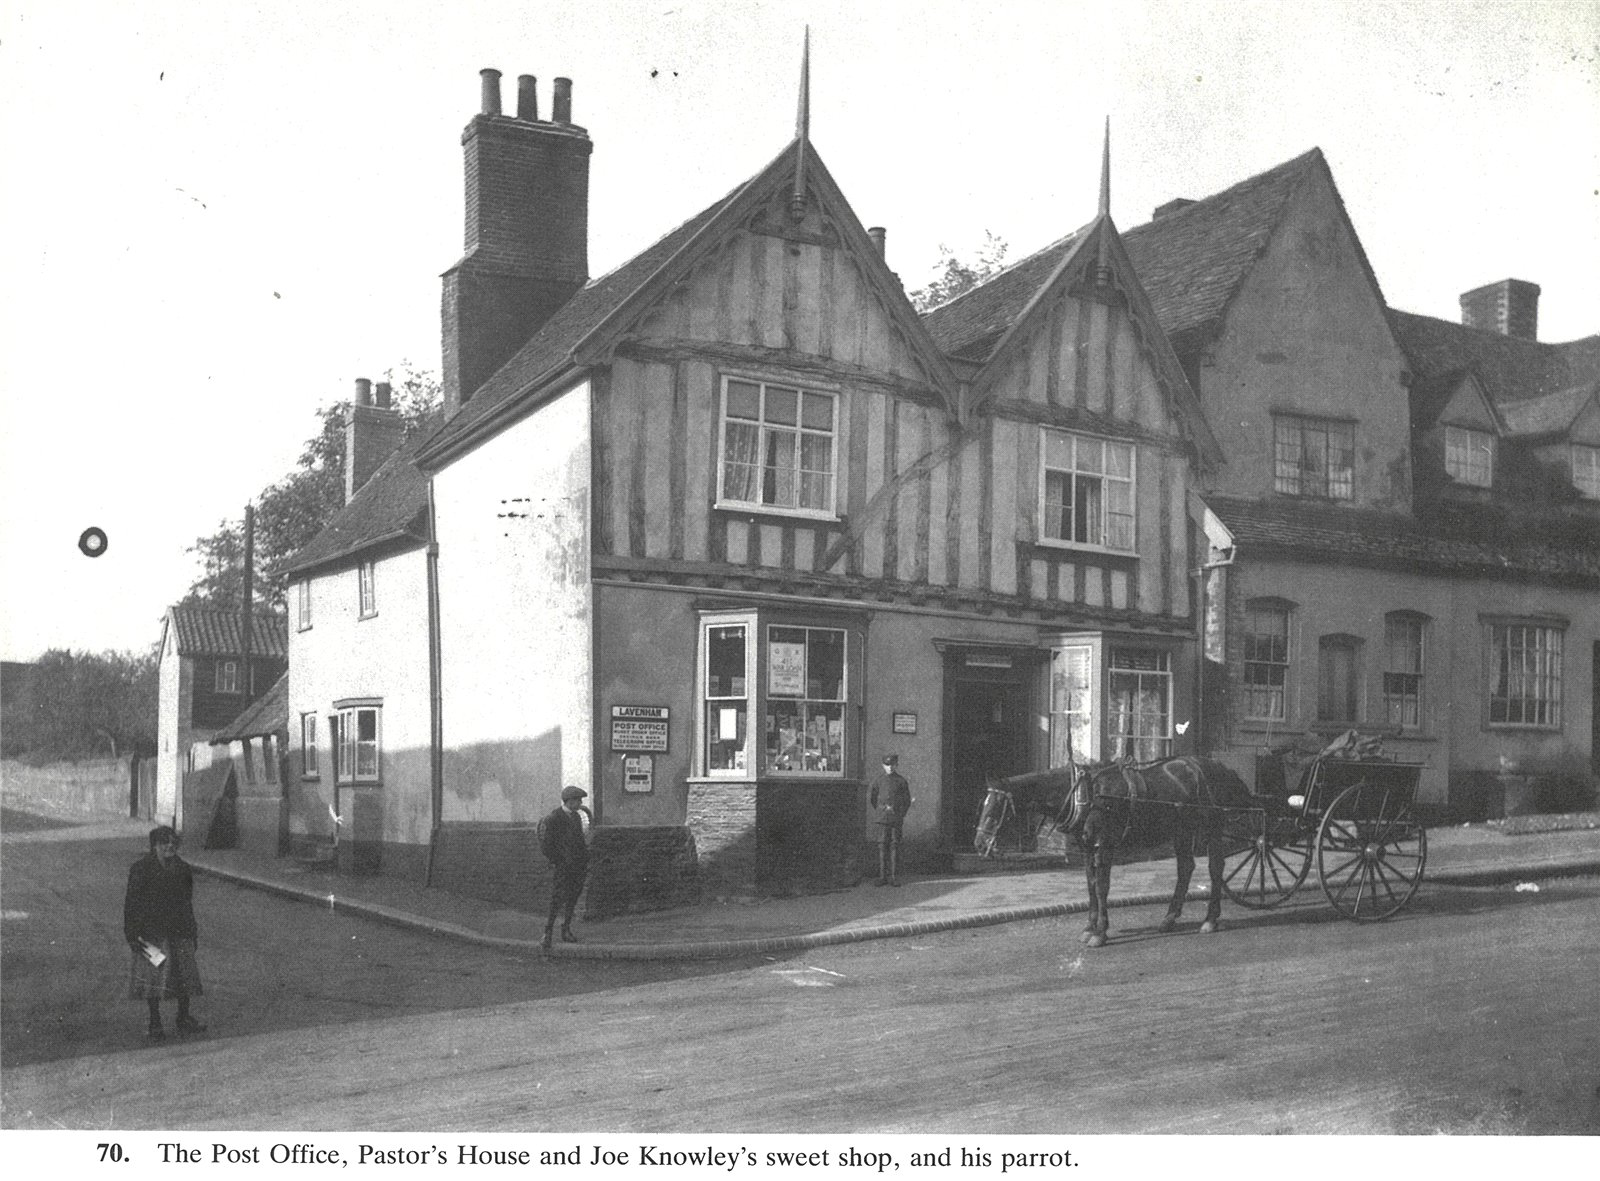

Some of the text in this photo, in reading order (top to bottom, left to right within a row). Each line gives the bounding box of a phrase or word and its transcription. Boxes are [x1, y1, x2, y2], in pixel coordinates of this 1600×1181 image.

[619, 707, 662, 717] LAVENHAM
[614, 722, 666, 731] POST OFFICE
